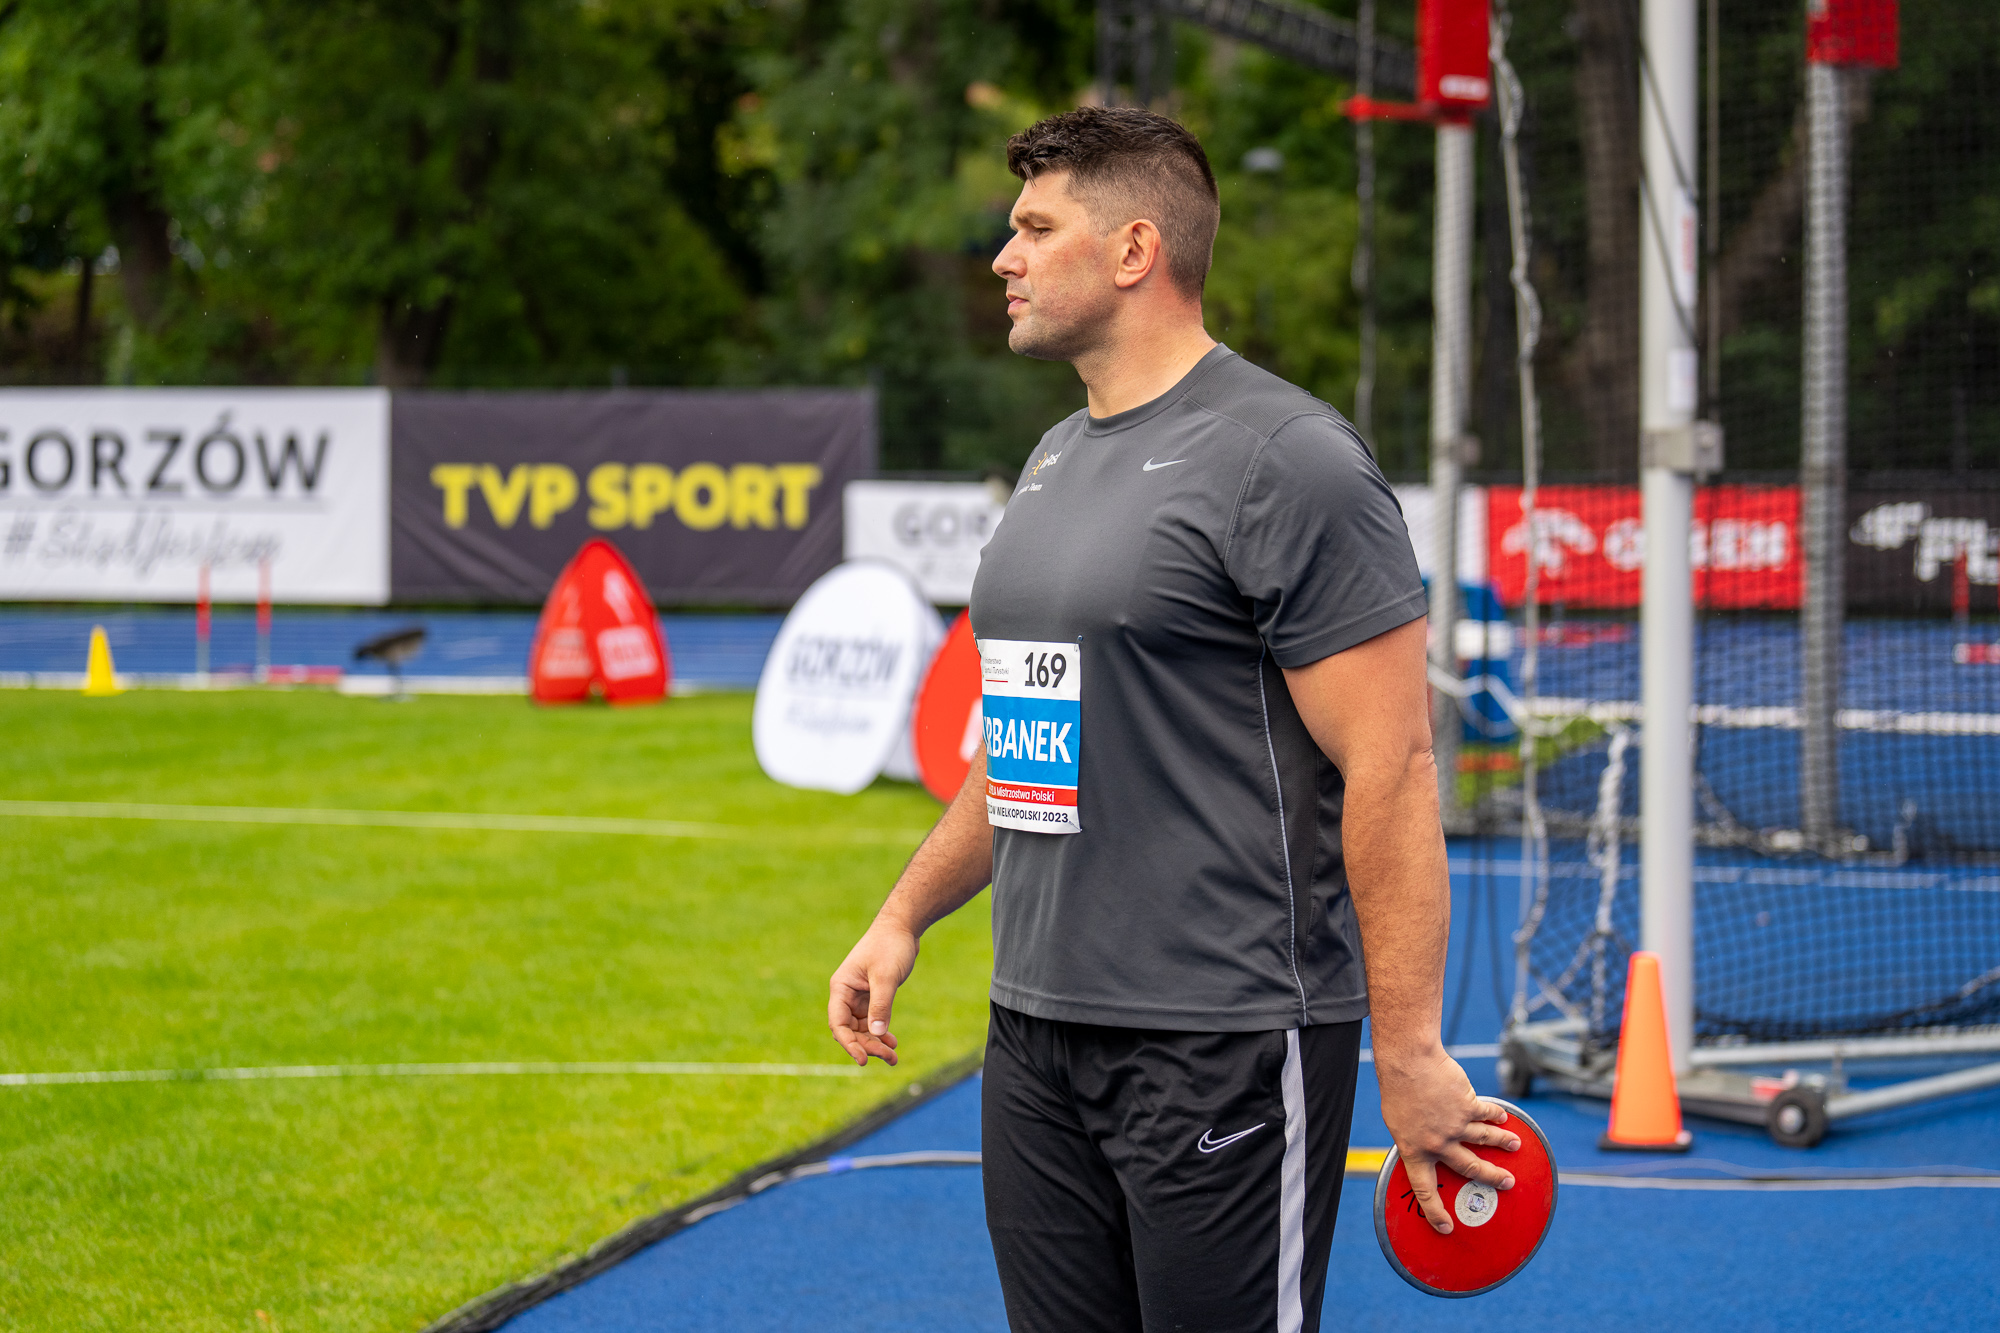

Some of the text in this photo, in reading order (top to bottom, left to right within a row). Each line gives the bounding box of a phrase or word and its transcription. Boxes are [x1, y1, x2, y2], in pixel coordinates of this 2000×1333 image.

[431, 462, 822, 531] TVP SPORT
[1024, 652, 1067, 688] 169
[997, 786, 1030, 800] Mistrzostwa
[1031, 790, 1055, 802] Polski
[1042, 811, 1069, 823] 2023
